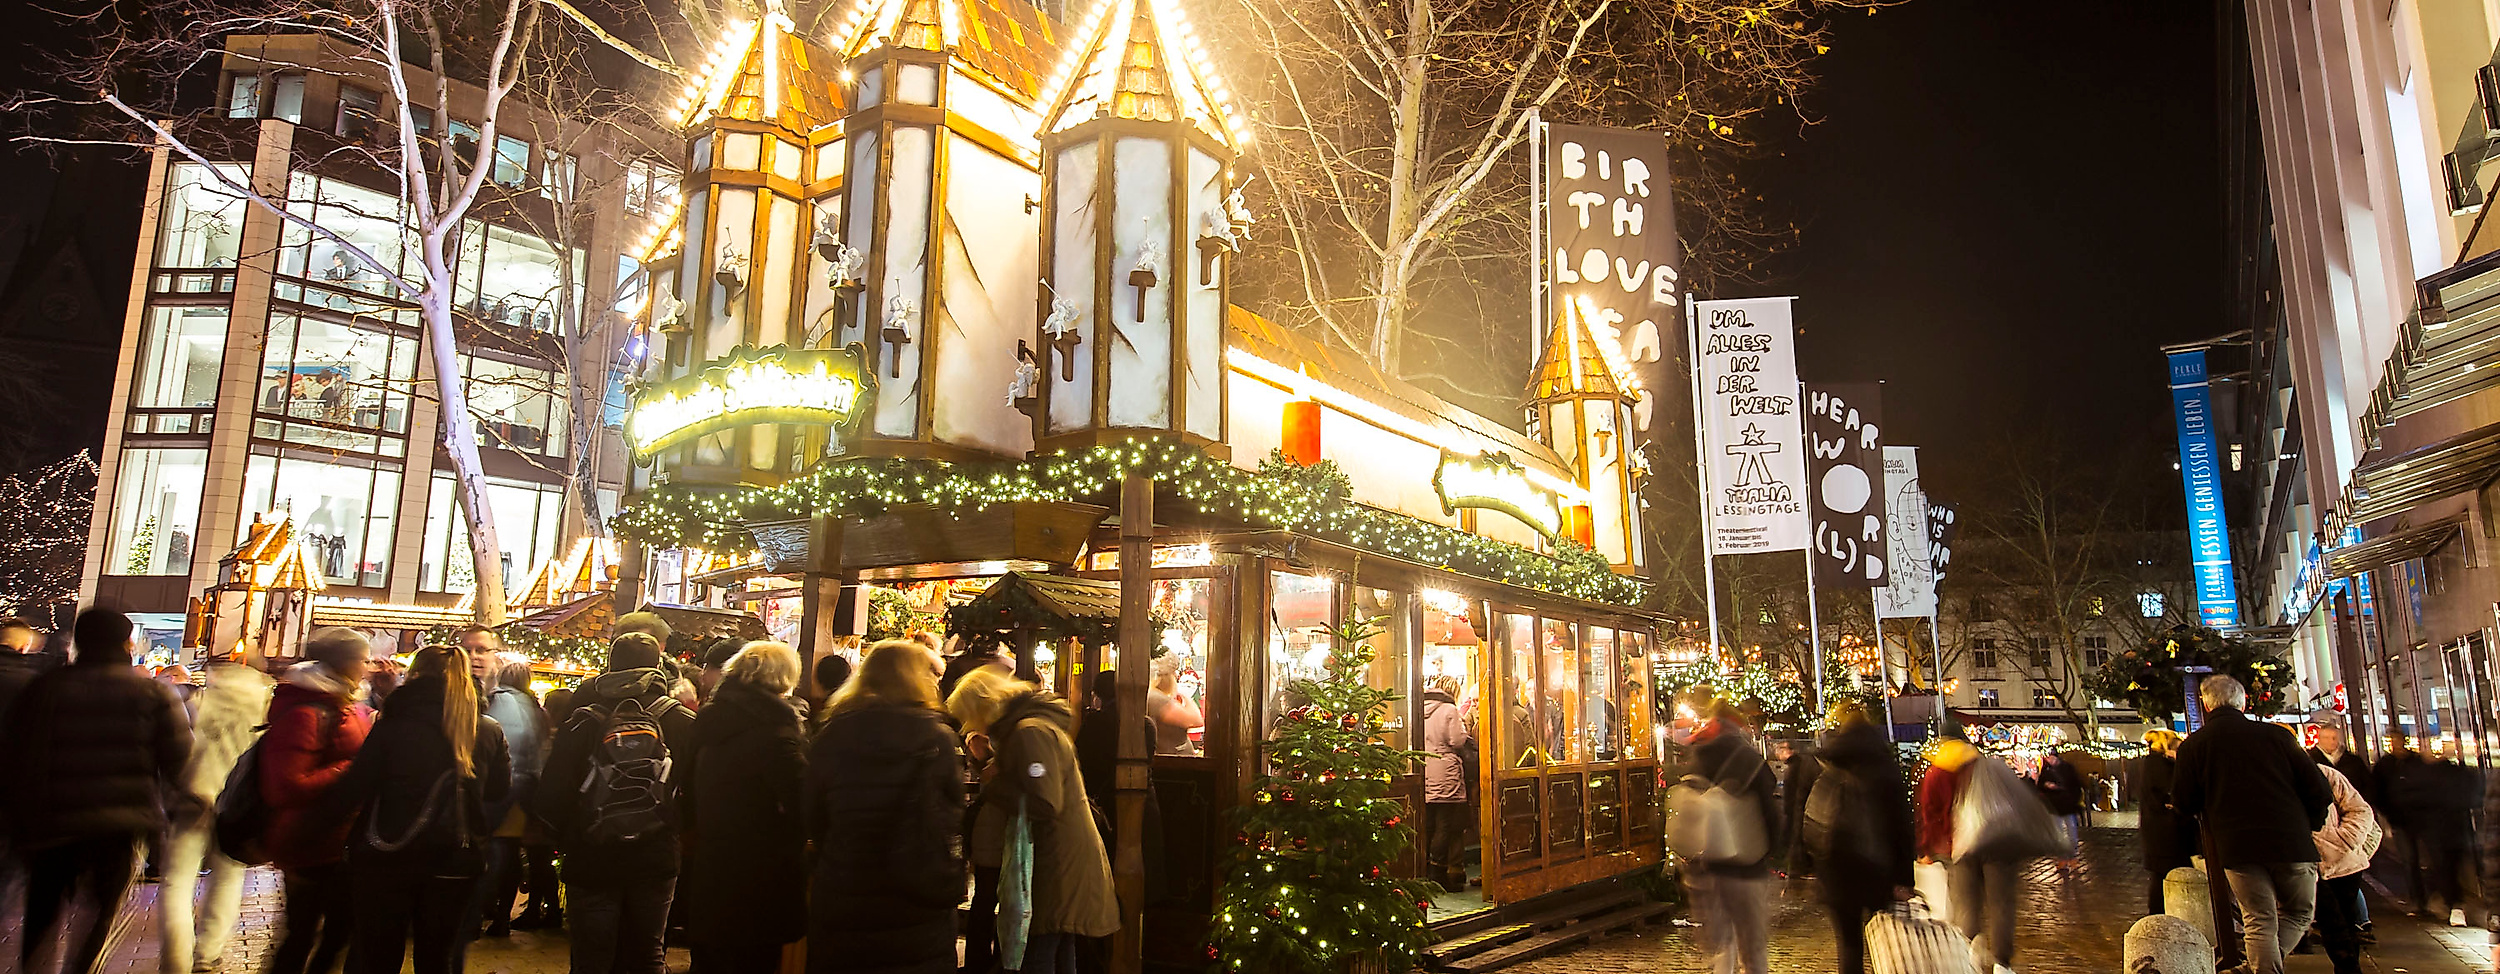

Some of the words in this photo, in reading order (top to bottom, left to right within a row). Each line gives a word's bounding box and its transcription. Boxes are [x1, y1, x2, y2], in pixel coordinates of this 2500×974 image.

[1555, 247, 1678, 307] LOVE
[1710, 310, 1755, 329] UM
[1706, 334, 1772, 355] ALLES
[1731, 355, 1760, 372] IN
[1716, 375, 1758, 394] DER
[1730, 395, 1793, 416] WELT
[1811, 391, 1879, 450] HEAR
[1725, 485, 1791, 505] THALIA
[1714, 502, 1801, 516] LESSINGTAGE
[1928, 503, 1954, 524] WHO
[1933, 522, 1944, 538] IS
